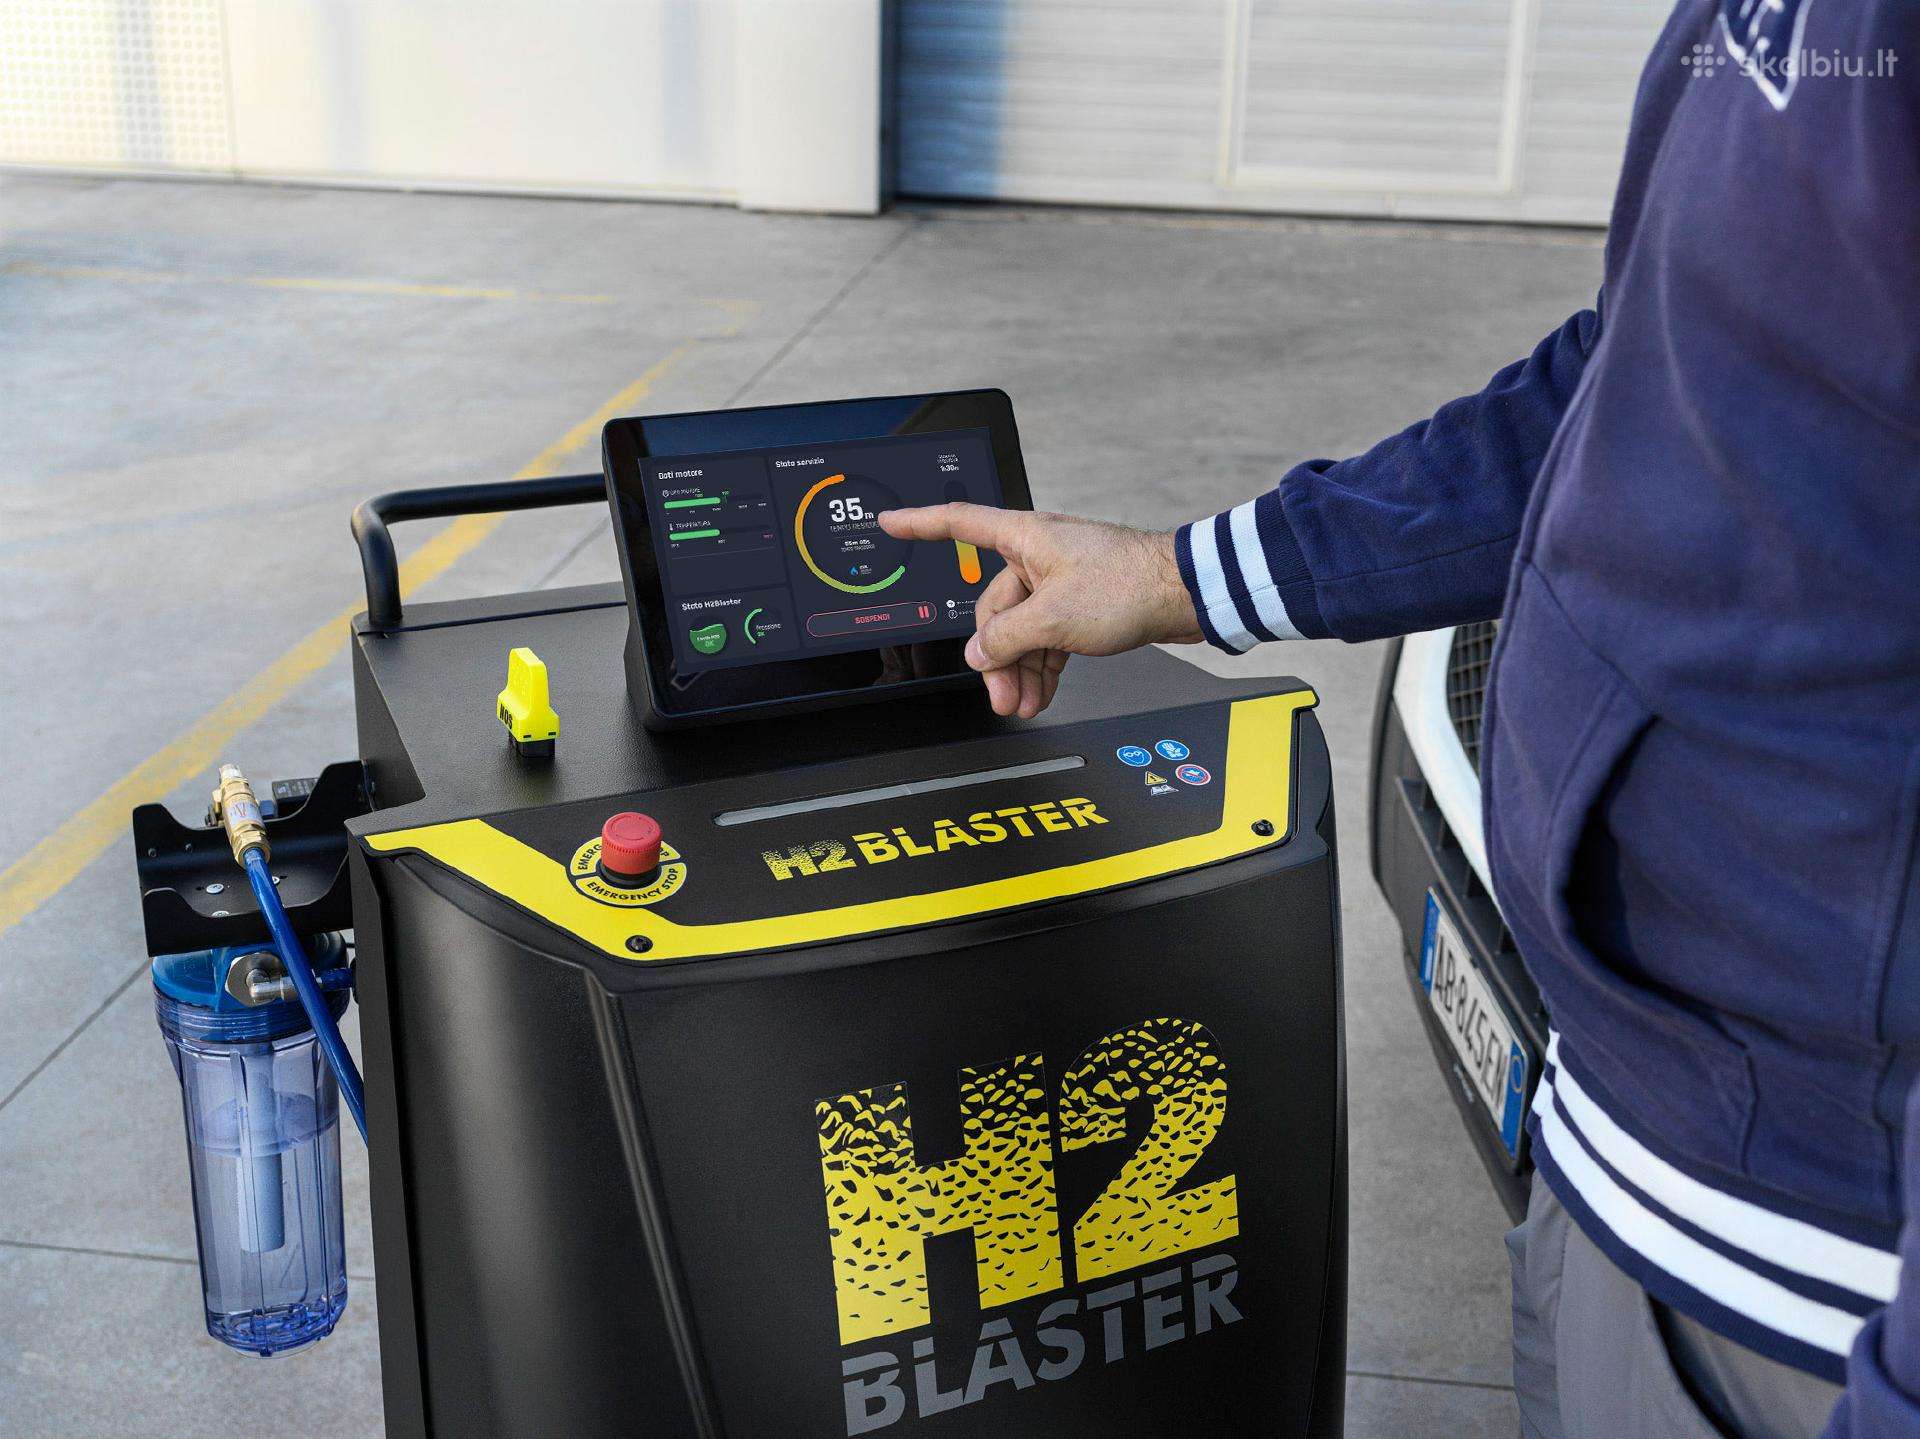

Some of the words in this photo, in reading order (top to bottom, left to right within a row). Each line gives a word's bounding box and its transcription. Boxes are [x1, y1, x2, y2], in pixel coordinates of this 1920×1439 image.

[854, 613, 891, 624] SOSPENDI
[577, 843, 603, 871] EMERG
[761, 838, 858, 881] H2
[852, 797, 1110, 865] BLASTER
[587, 881, 662, 901] EMERGENCY
[661, 867, 679, 890] STOP
[814, 1017, 1240, 1347] H2
[841, 1252, 1244, 1437] BLASTER
